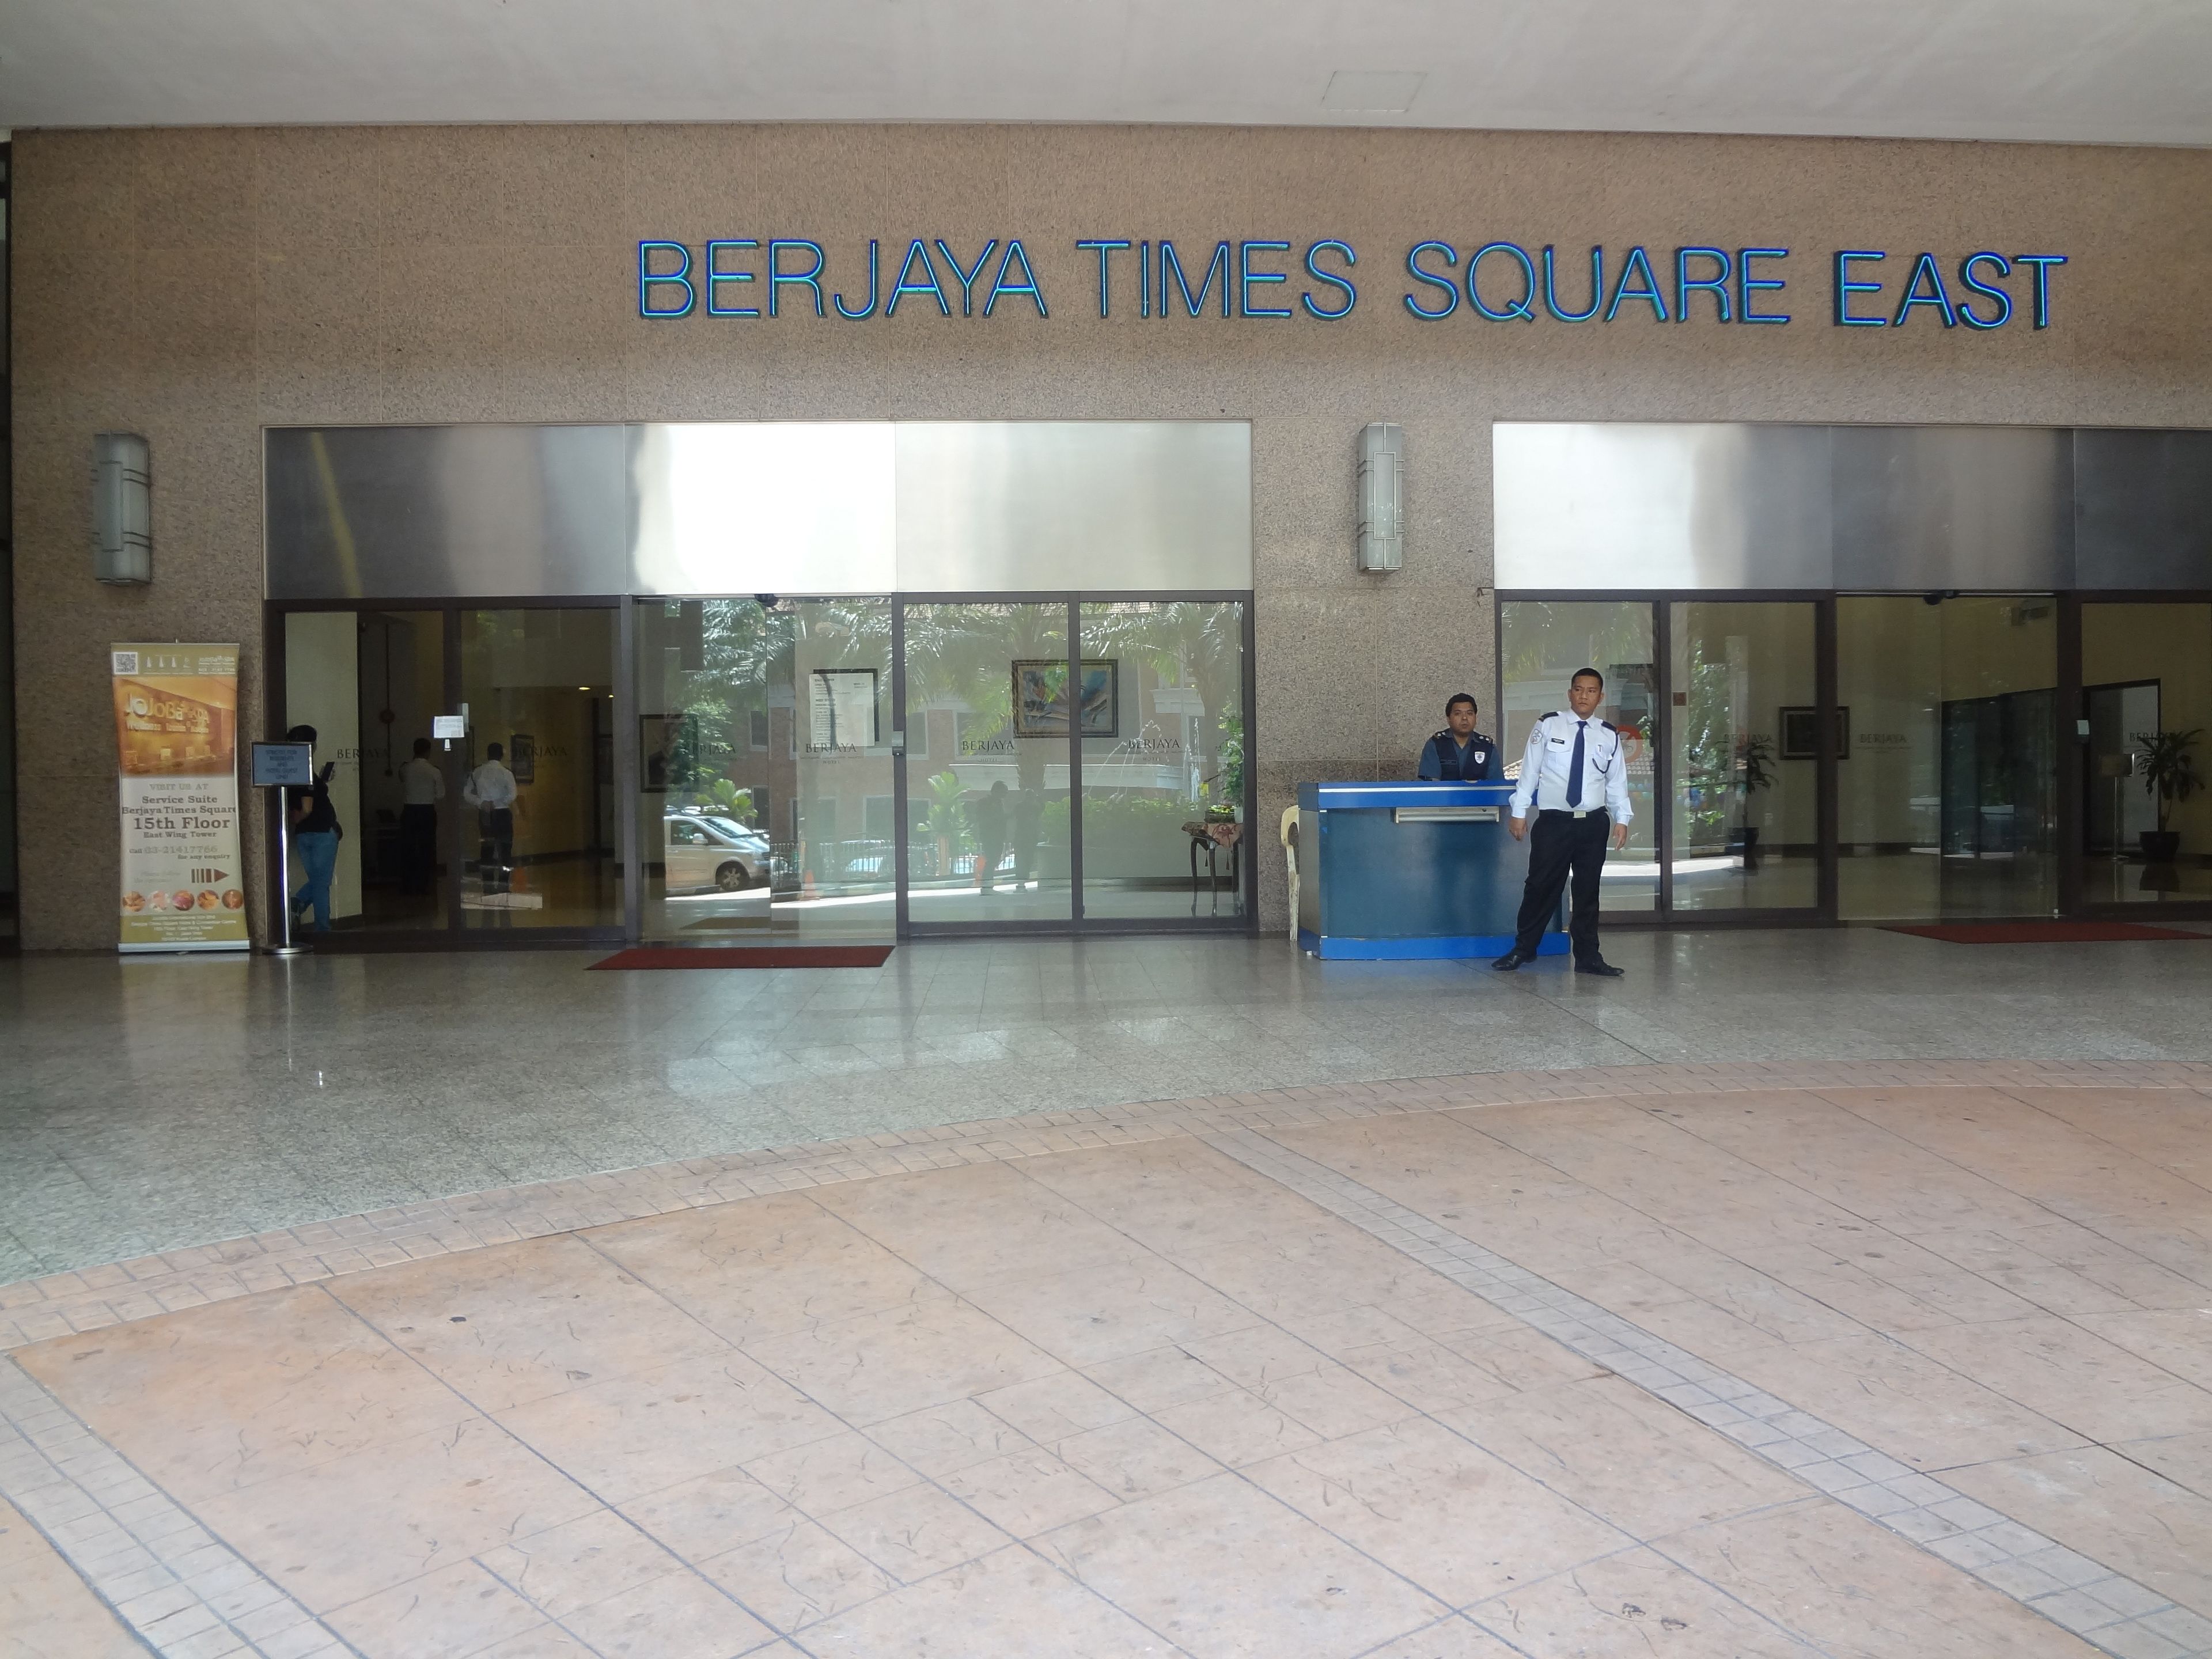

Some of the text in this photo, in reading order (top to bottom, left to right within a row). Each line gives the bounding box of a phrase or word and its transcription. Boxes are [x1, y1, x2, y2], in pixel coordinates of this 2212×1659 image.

[637, 238, 2069, 329] BERJAYA TIMES SQUARE EAST
[805, 743, 857, 755] BERJAYA
[963, 740, 1014, 751] BERJAYA
[1129, 738, 1180, 750] BERJAYA
[142, 796, 184, 804] Service
[122, 806, 161, 816] Berjaya
[134, 816, 230, 830] 15th Floor
